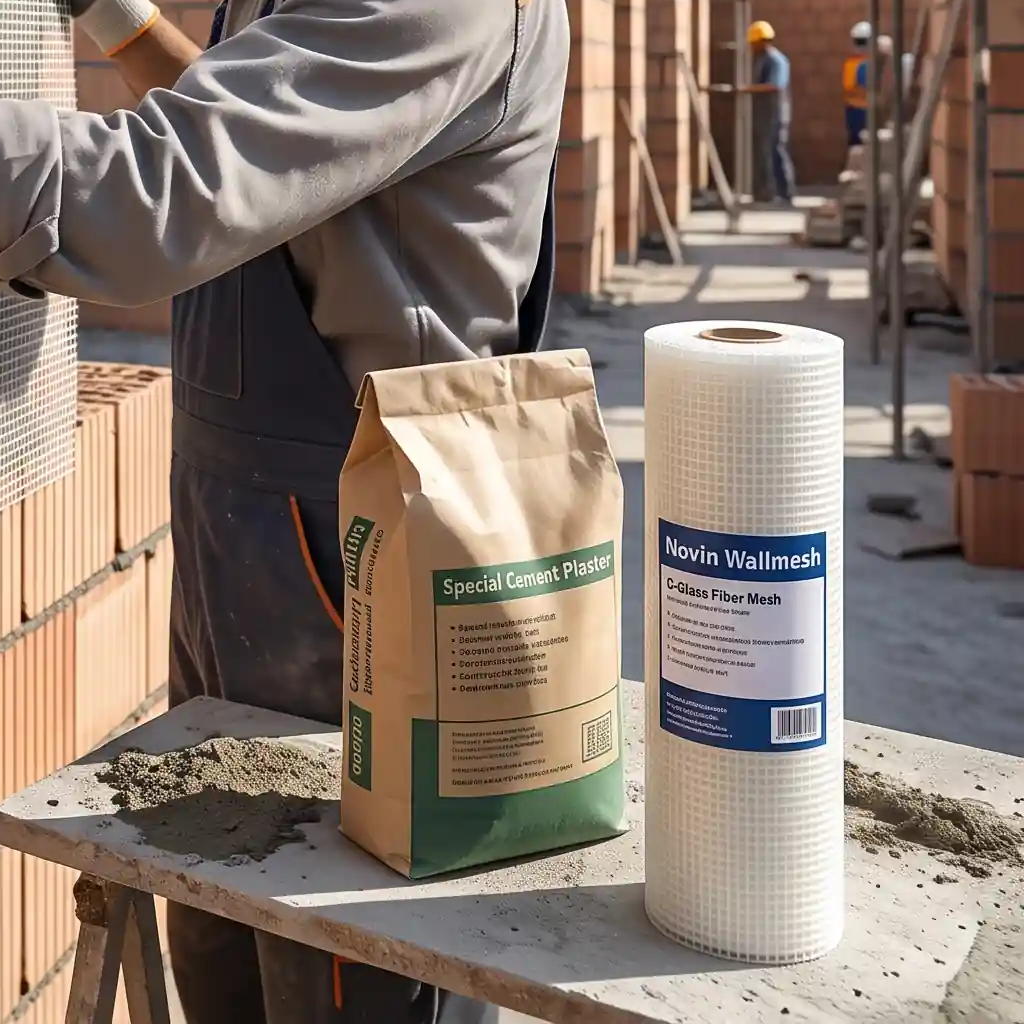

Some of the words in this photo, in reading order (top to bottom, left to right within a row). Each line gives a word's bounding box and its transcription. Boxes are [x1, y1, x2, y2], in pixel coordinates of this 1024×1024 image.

[666, 535, 719, 566] Novin
[725, 546, 821, 570] Wallmesh
[443, 573, 502, 599] Special
[506, 566, 560, 589] Cement
[562, 554, 612, 580] Plaster
[666, 577, 709, 599] C-Glass
[712, 589, 745, 604] Fiber
[747, 593, 782, 606] Mesh
